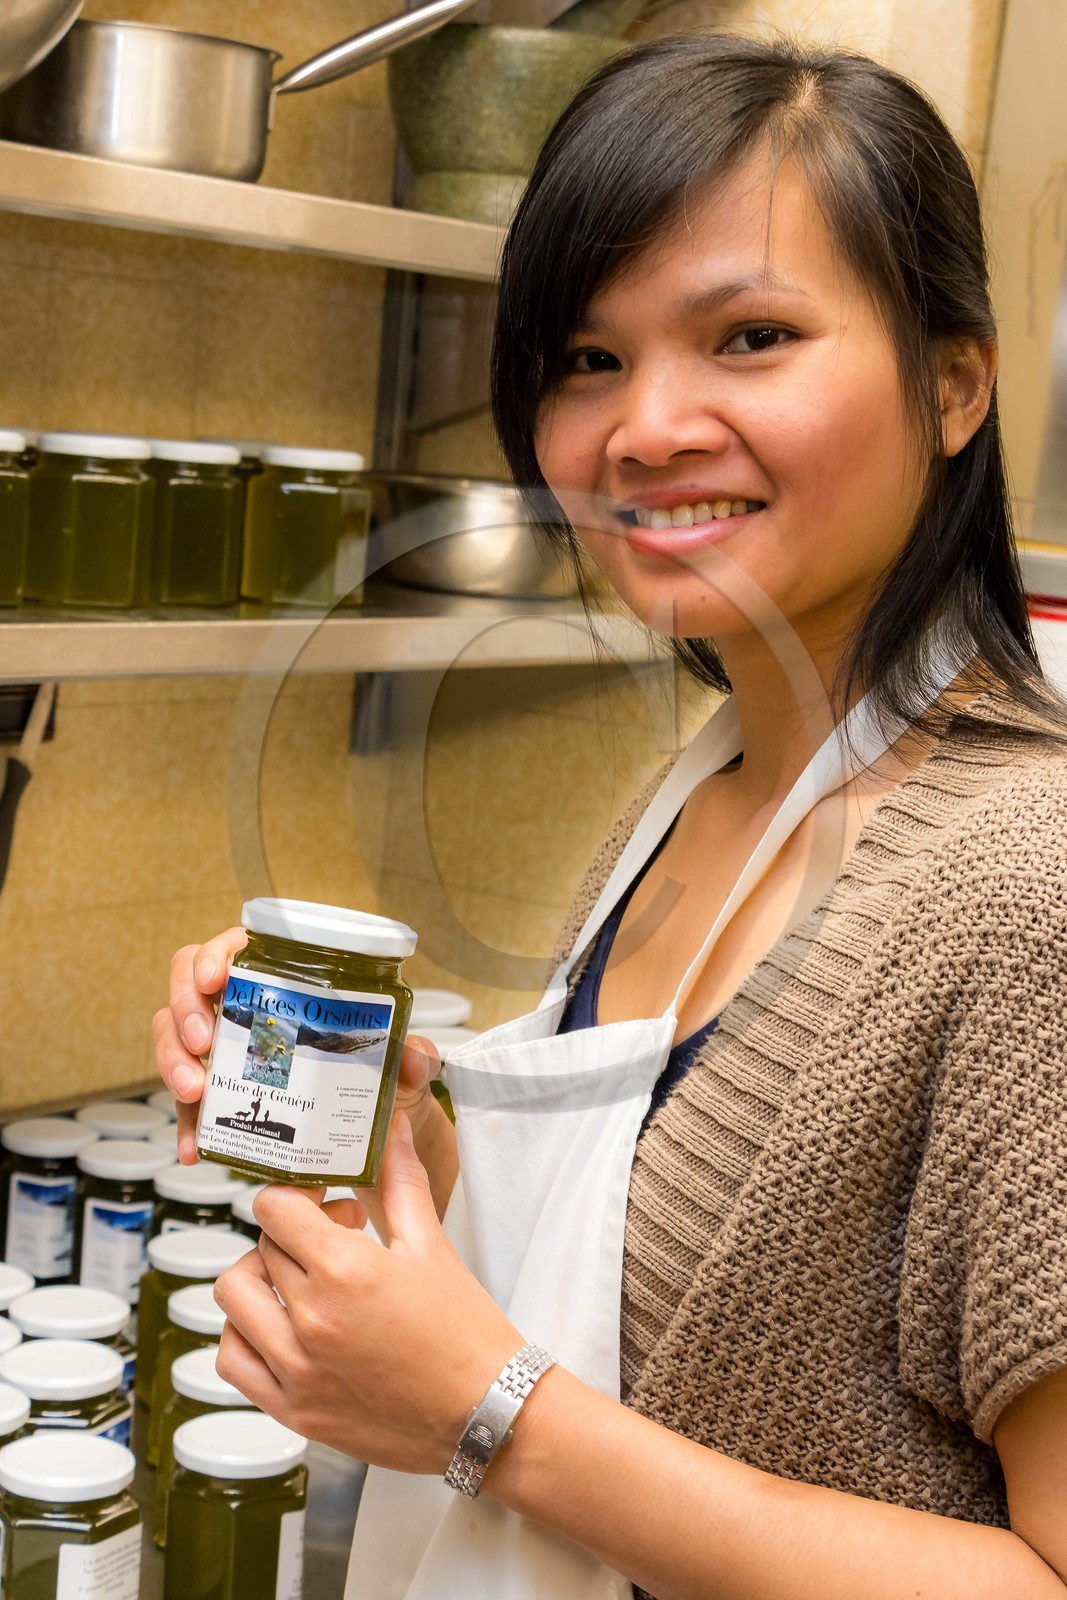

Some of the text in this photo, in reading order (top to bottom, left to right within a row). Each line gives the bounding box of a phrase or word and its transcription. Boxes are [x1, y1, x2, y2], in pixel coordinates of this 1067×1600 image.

[303, 999, 383, 1029] Orsatus
[211, 1074, 315, 1112] Délice de Génépi
[230, 1119, 281, 1139] Produit Artisanal
